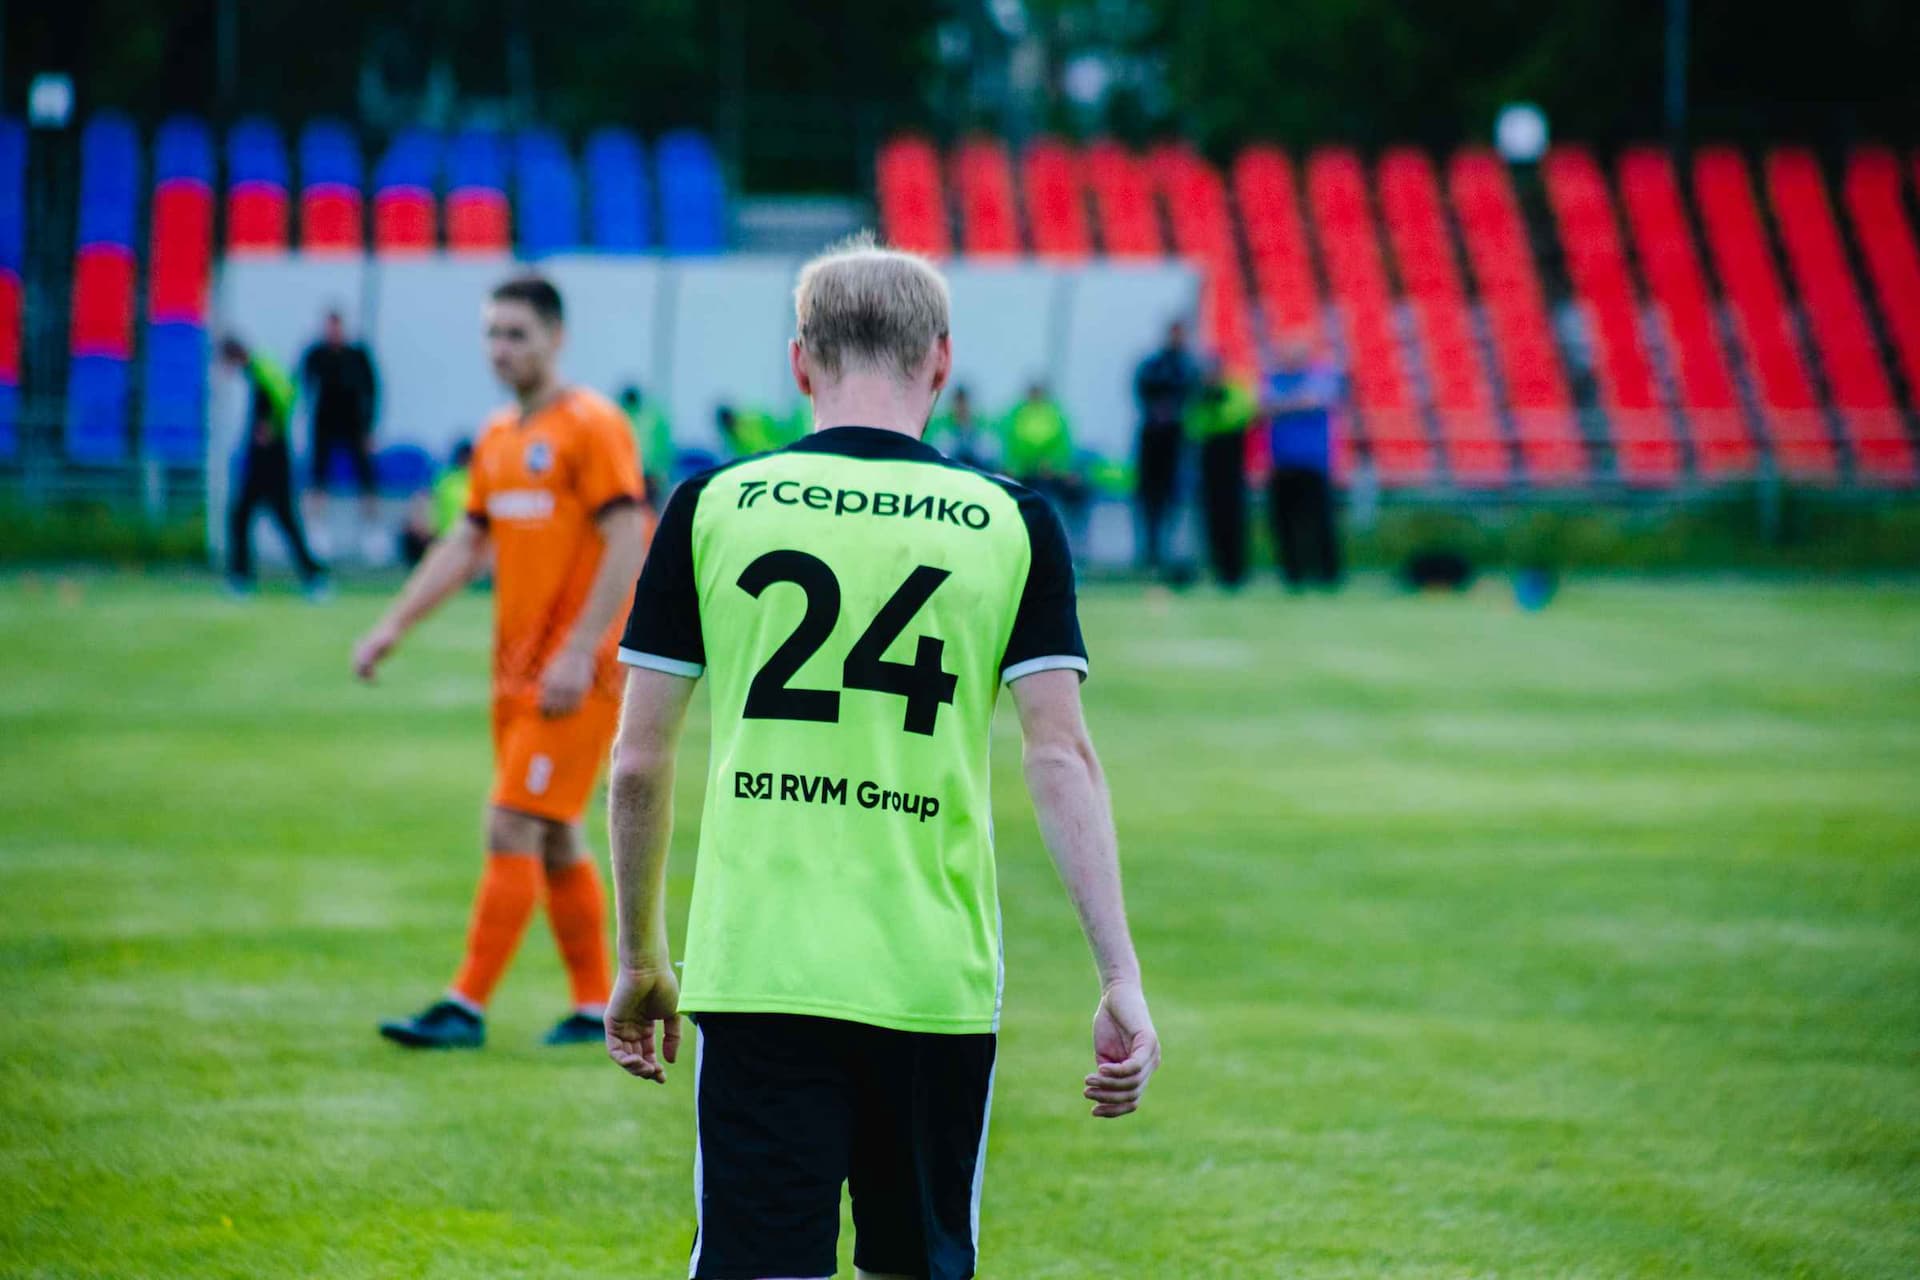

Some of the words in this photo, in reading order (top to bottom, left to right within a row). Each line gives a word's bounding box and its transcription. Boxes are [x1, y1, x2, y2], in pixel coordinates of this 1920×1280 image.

[736, 549, 959, 737] 24
[780, 774, 848, 806] RVM
[856, 781, 940, 823] Group
